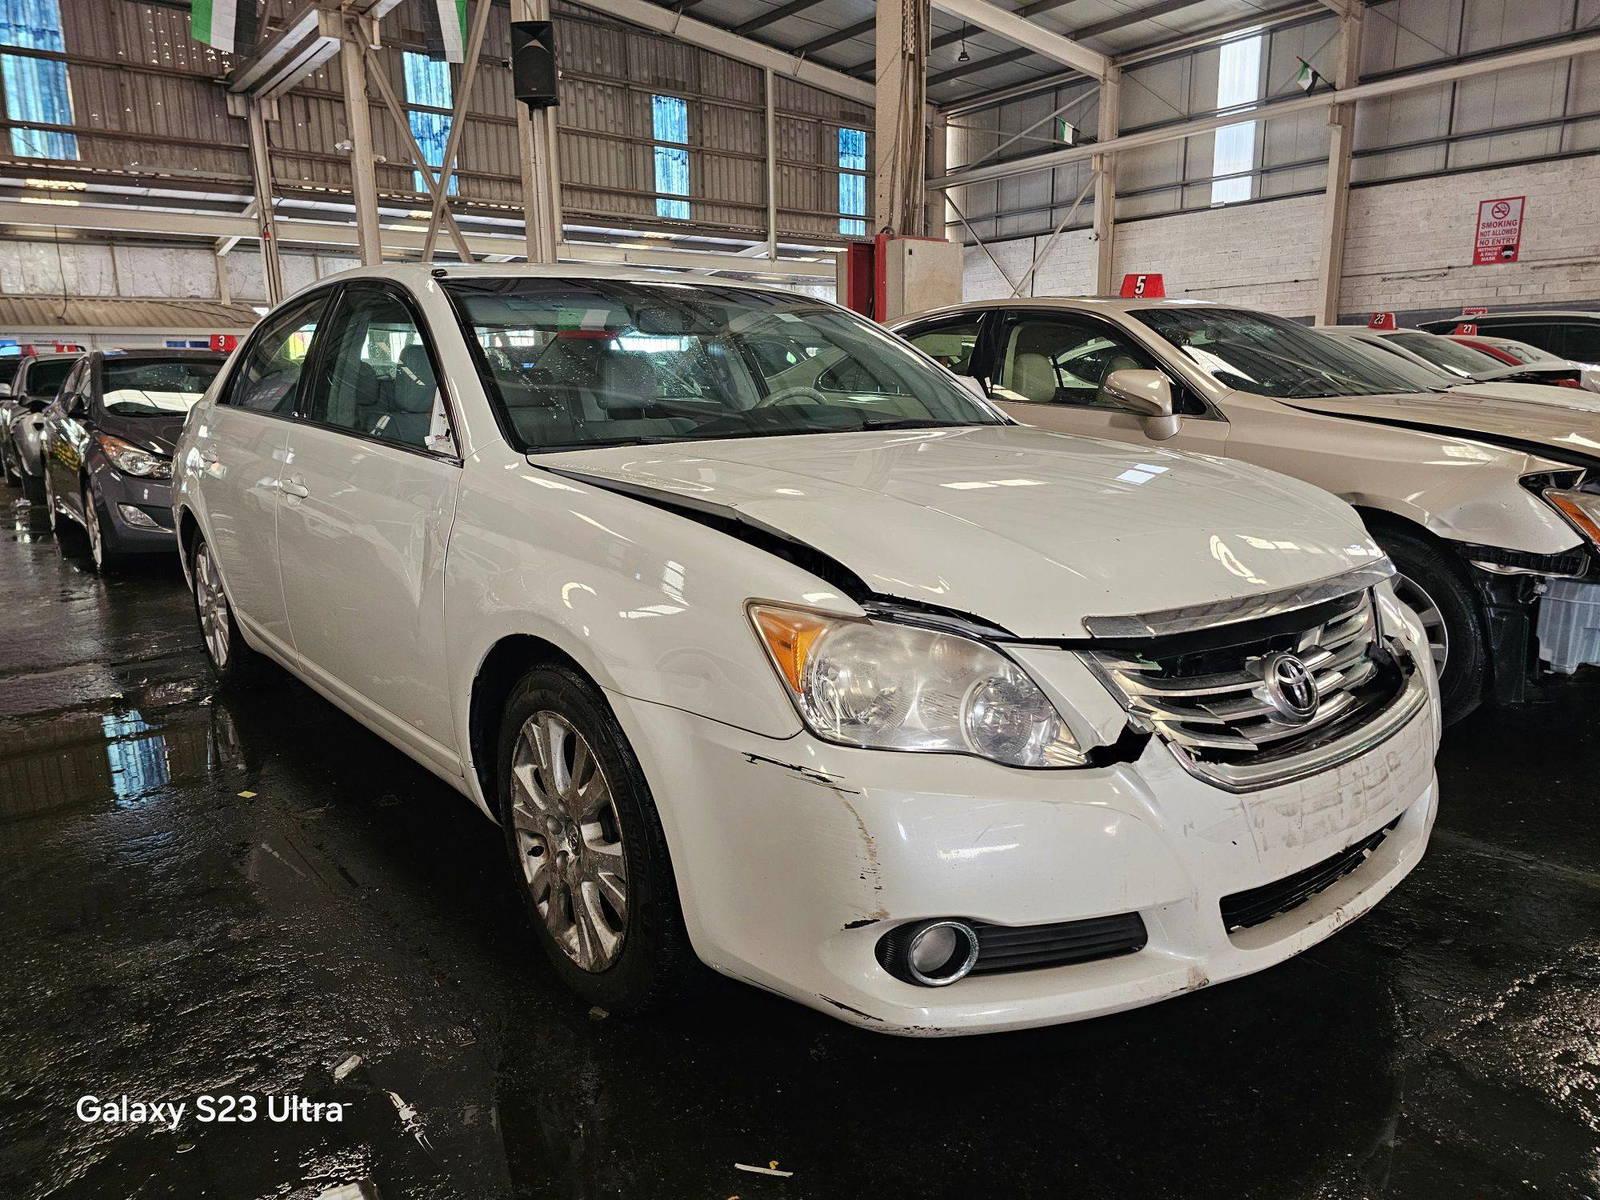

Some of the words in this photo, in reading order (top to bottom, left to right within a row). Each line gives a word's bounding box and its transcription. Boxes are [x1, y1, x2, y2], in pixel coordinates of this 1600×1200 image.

[1481, 220, 1518, 230] SMOKING
[1492, 228, 1517, 236] ALLOWED
[1491, 237, 1516, 245] ENTRY
[1134, 275, 1147, 295] 5
[1373, 313, 1386, 325] 23
[1463, 324, 1472, 333] 27
[218, 335, 225, 347] 3
